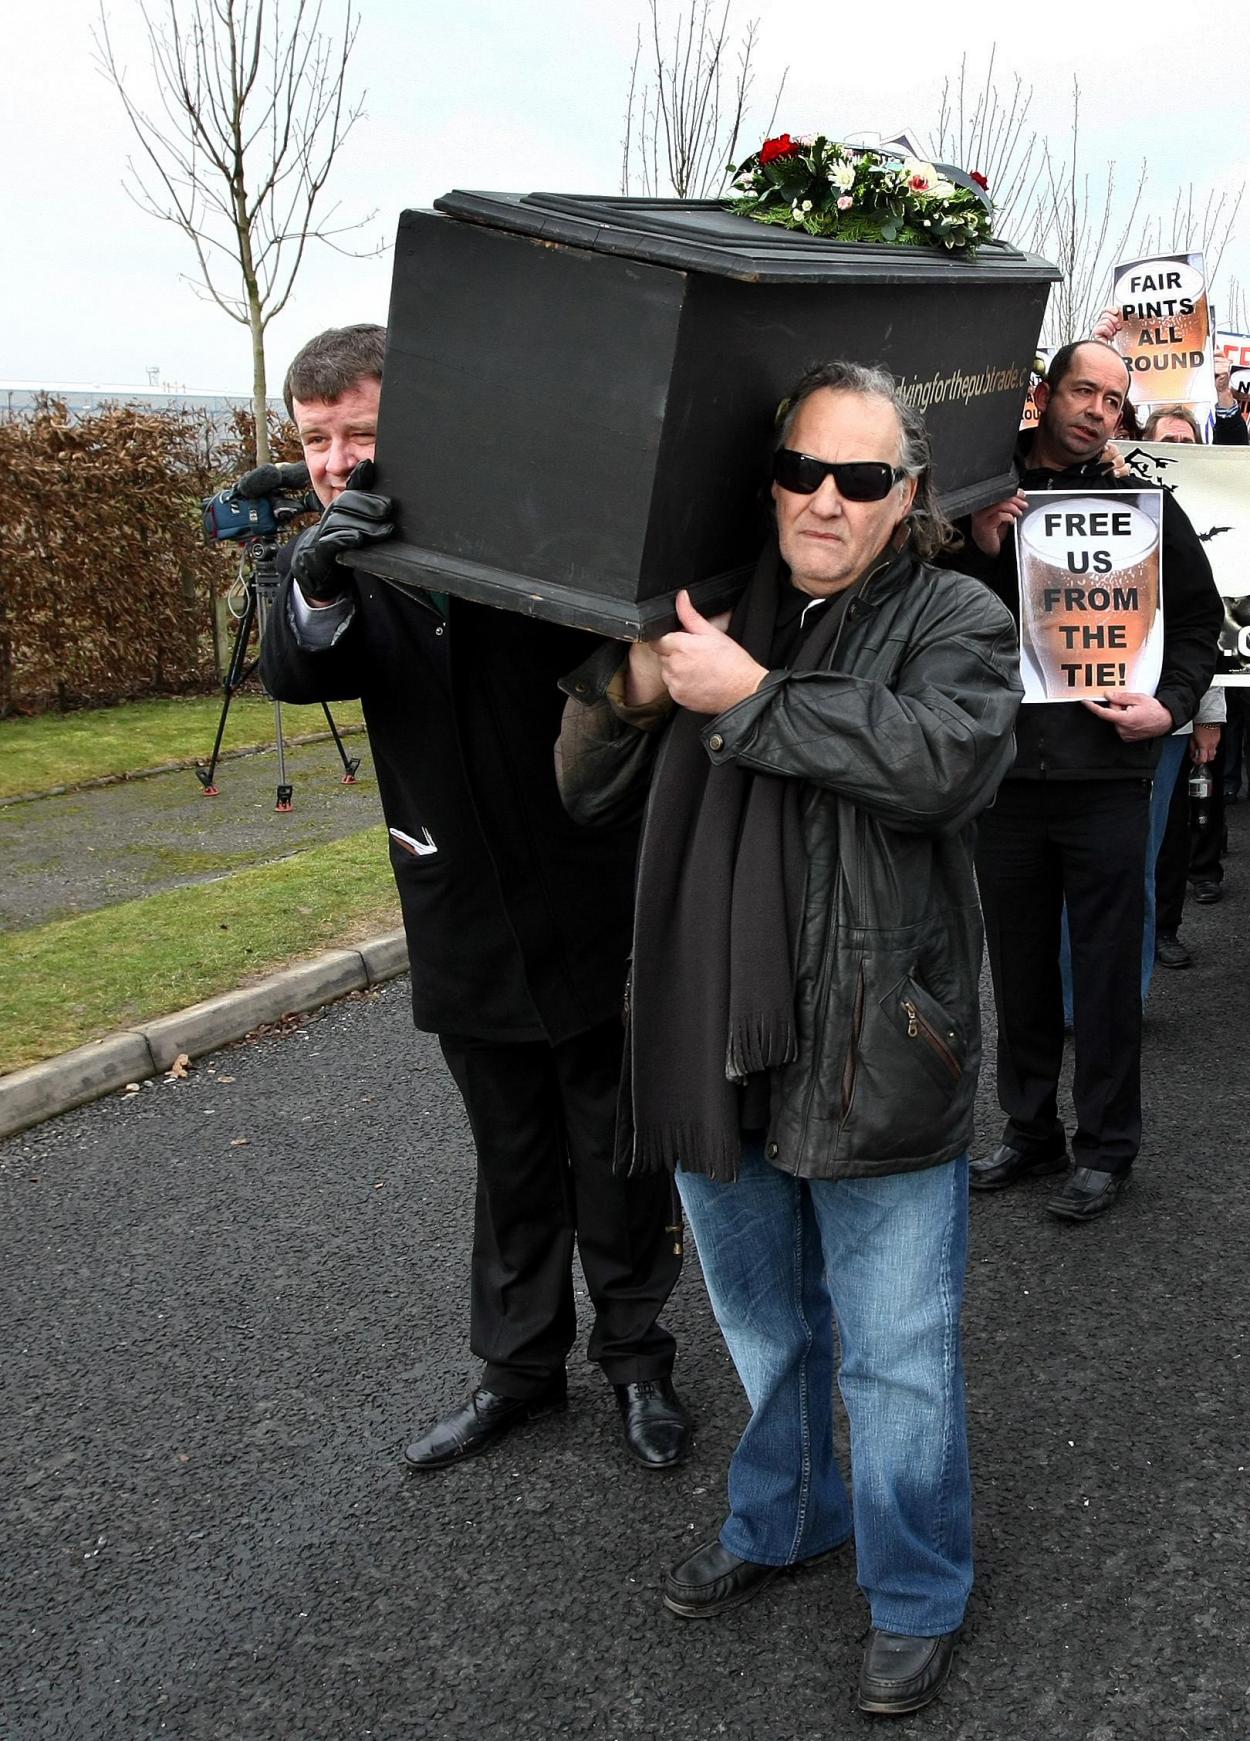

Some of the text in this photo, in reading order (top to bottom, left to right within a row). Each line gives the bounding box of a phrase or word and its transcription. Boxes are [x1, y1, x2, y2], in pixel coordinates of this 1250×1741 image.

[1131, 272, 1182, 293] FAIR
[1122, 298, 1194, 321] PINTS
[1138, 327, 1183, 346] ALL
[1044, 513, 1132, 536] FREE
[1067, 550, 1113, 574] US
[1044, 587, 1139, 611] FROM
[1058, 625, 1127, 649] THE
[1061, 663, 1126, 687] TIE!
